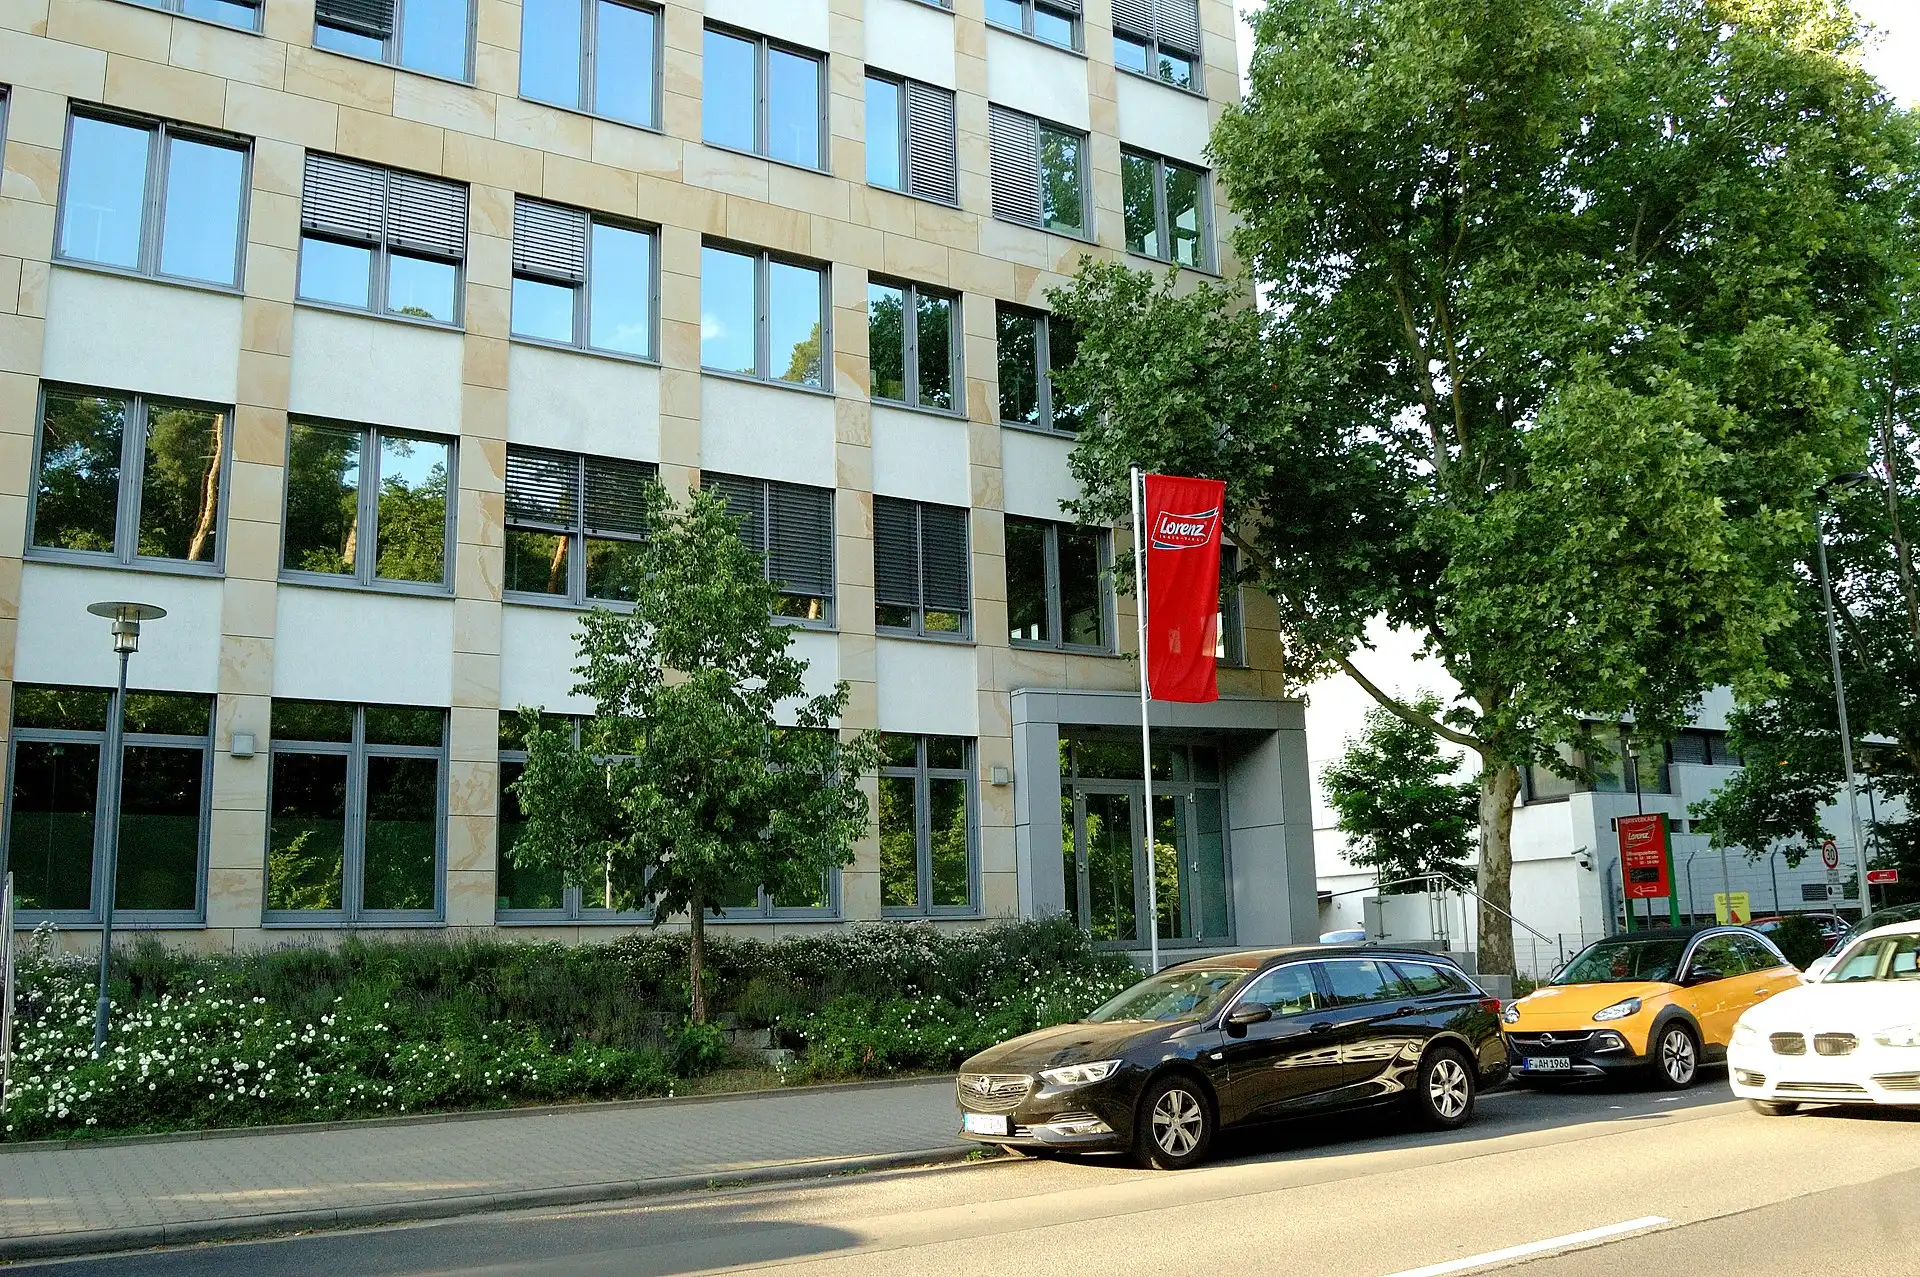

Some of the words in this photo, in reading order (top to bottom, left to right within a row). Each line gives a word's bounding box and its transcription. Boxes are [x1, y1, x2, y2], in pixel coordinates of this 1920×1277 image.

[1160, 517, 1206, 537] Lorenz
[1825, 848, 1835, 861] 30
[1550, 1059, 1569, 1069] 1966
